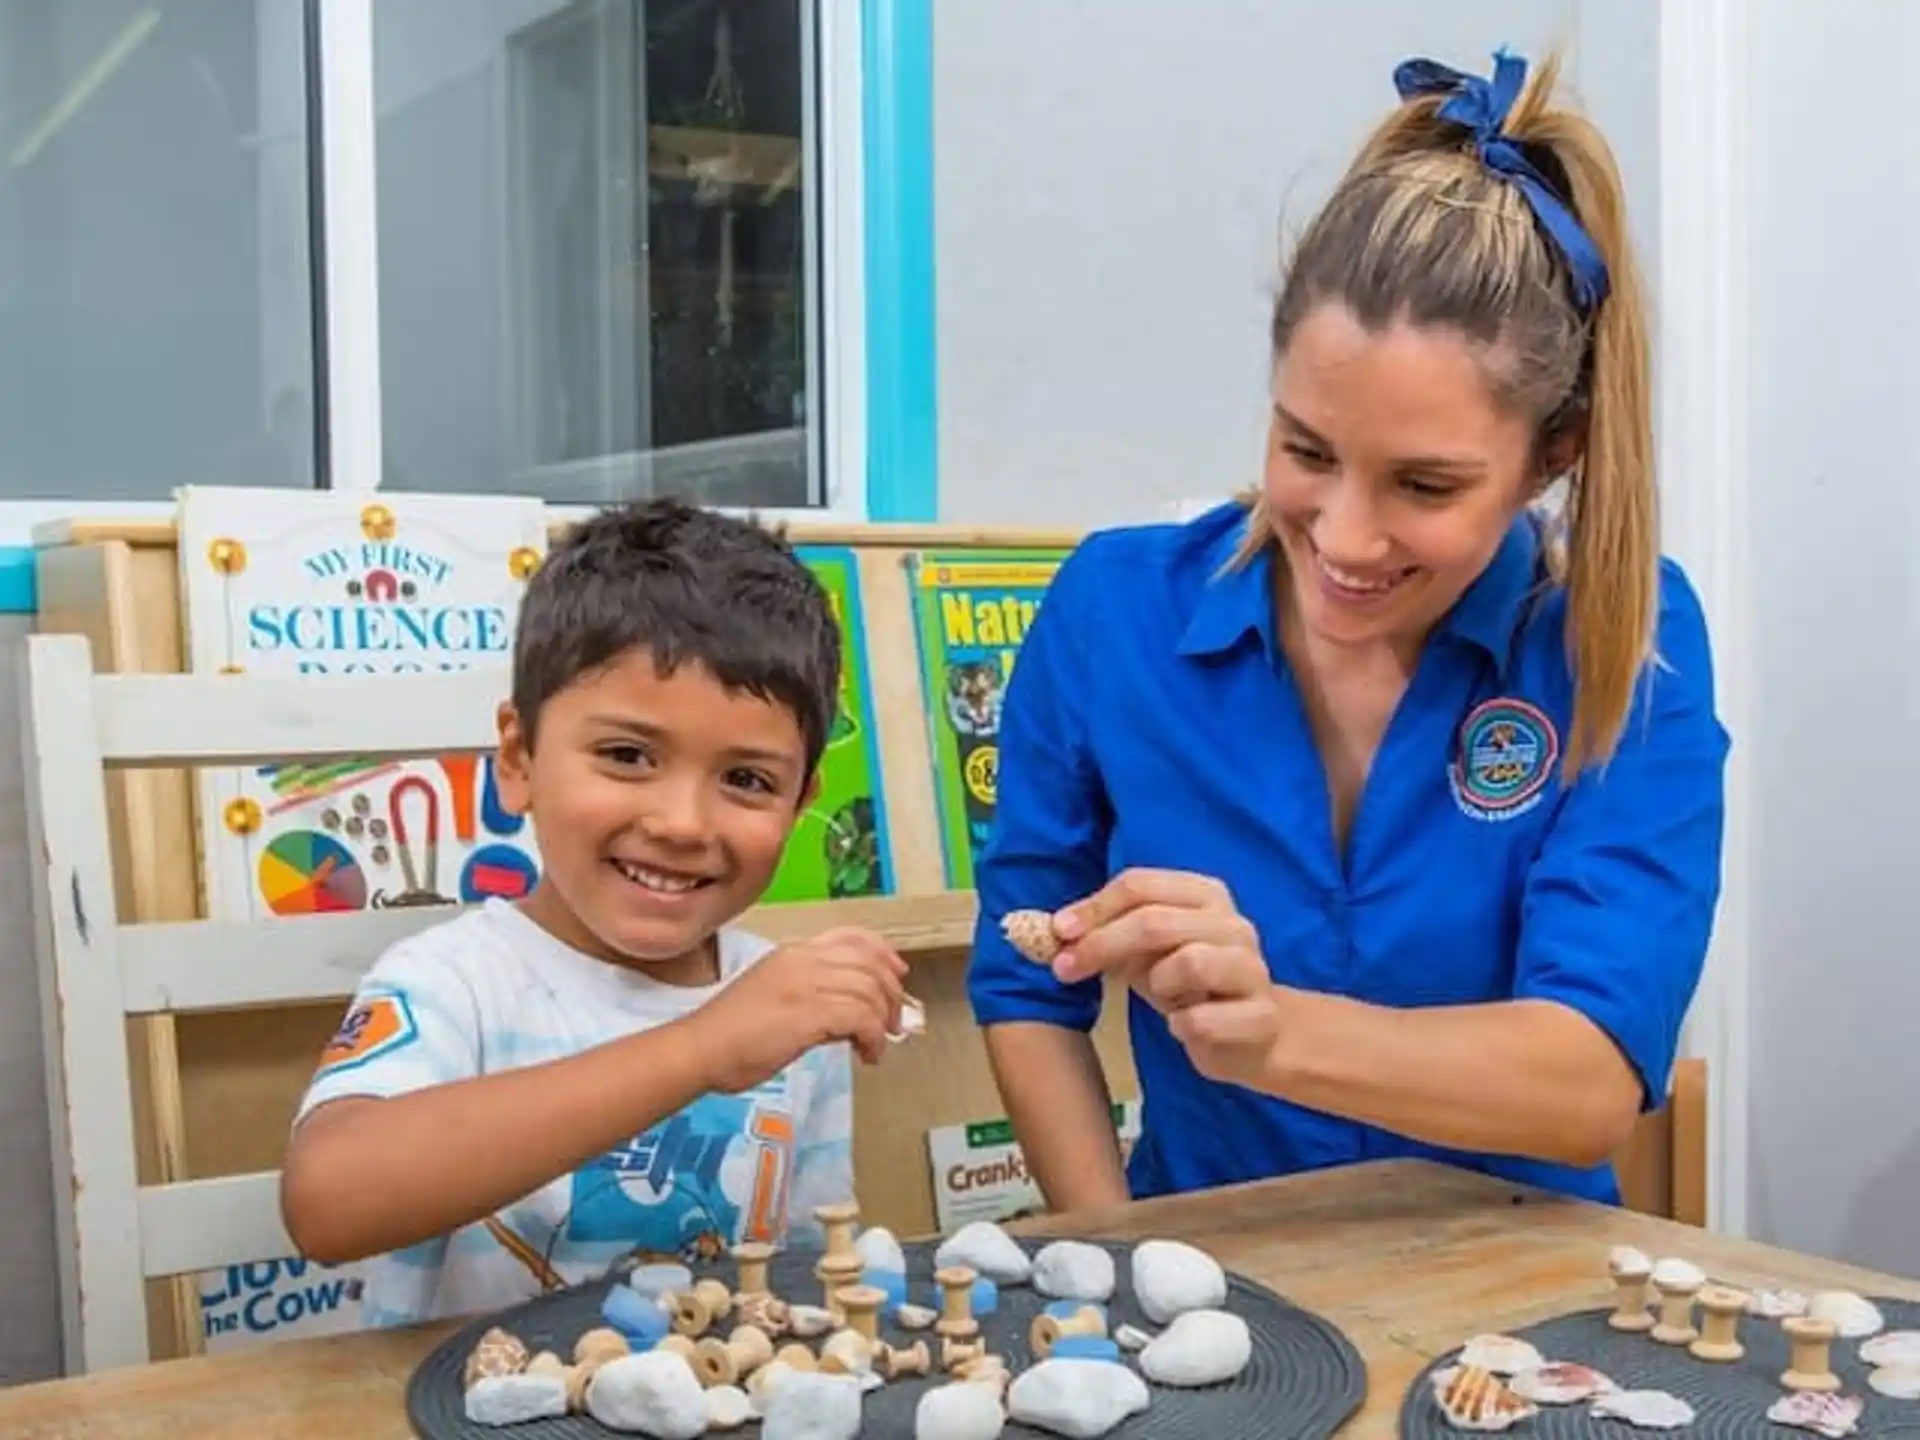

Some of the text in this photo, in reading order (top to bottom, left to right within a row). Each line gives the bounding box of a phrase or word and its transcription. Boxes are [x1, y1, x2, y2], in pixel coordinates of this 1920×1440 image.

[304, 543, 452, 583] MY FIRST
[249, 606, 508, 651] SCIENCE
[244, 1278, 345, 1333] Cow
